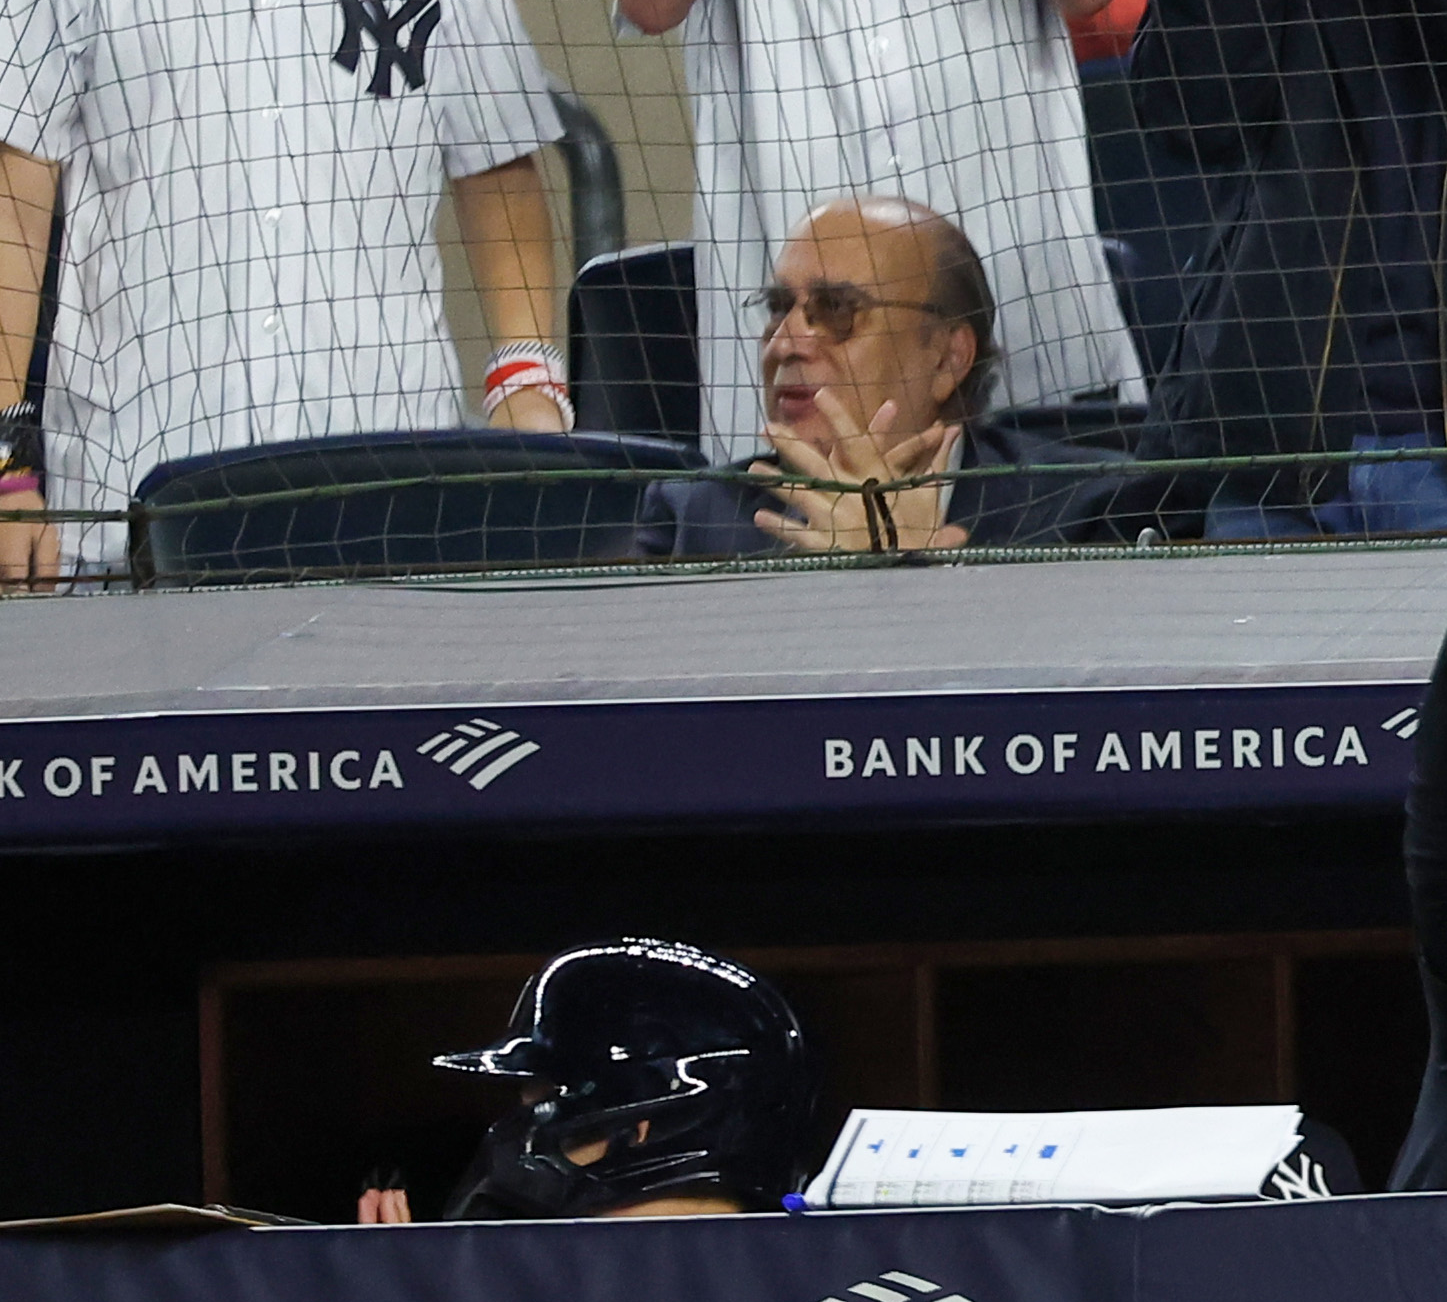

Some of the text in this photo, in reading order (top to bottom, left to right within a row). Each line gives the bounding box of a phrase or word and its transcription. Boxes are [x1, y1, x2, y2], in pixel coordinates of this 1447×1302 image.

[43, 756, 116, 799] OF
[133, 750, 404, 795] AMERICA
[824, 726, 1370, 779] BANK OF AMERICA
